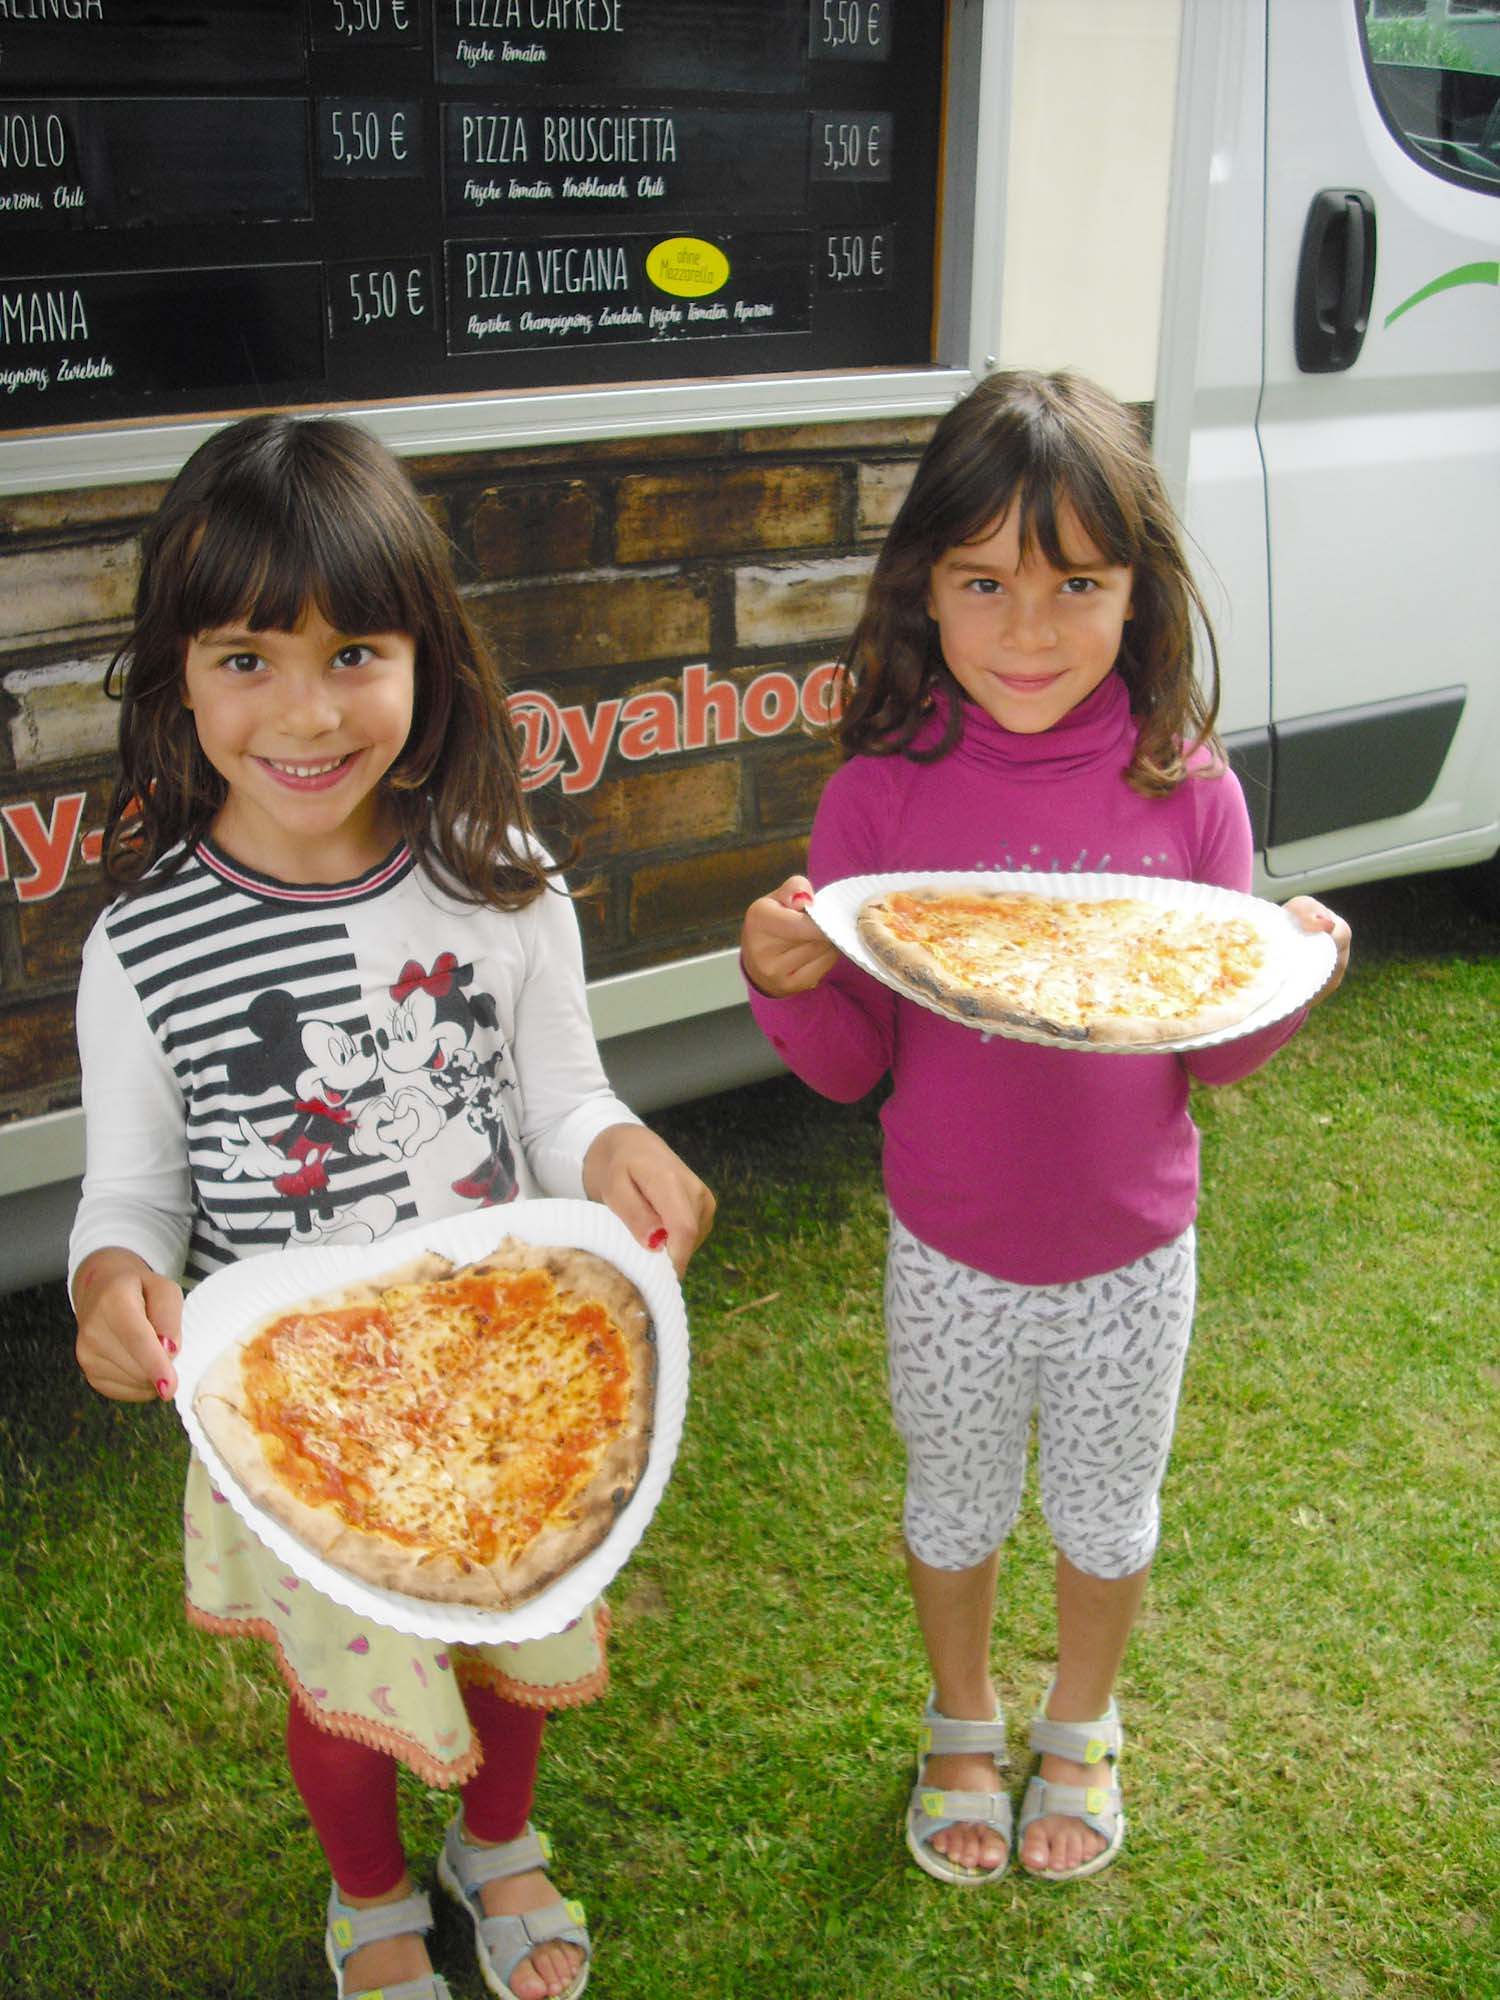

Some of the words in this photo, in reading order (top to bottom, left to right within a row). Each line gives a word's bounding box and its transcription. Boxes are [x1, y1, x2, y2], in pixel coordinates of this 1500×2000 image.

[823, 0, 860, 46] 5,50
[867, 3, 880, 45] €
[501, 40, 548, 63] Tomaten
[332, 111, 380, 165] 5,50
[390, 112, 407, 160] €
[462, 116, 528, 162] PIZZA
[543, 116, 677, 162] BRUSCHETTA
[824, 124, 860, 171] 5,50
[867, 126, 880, 167] €
[53, 185, 86, 208] Chili
[637, 175, 665, 198] Chili
[466, 251, 532, 298] PIZZA
[536, 247, 628, 294] VEGANA
[676, 246, 702, 266] ohne
[828, 236, 865, 281] 5,50
[871, 235, 884, 275] €
[349, 270, 397, 325] 5,50
[406, 268, 424, 316] €
[57, 356, 114, 381] Zwiebeln
